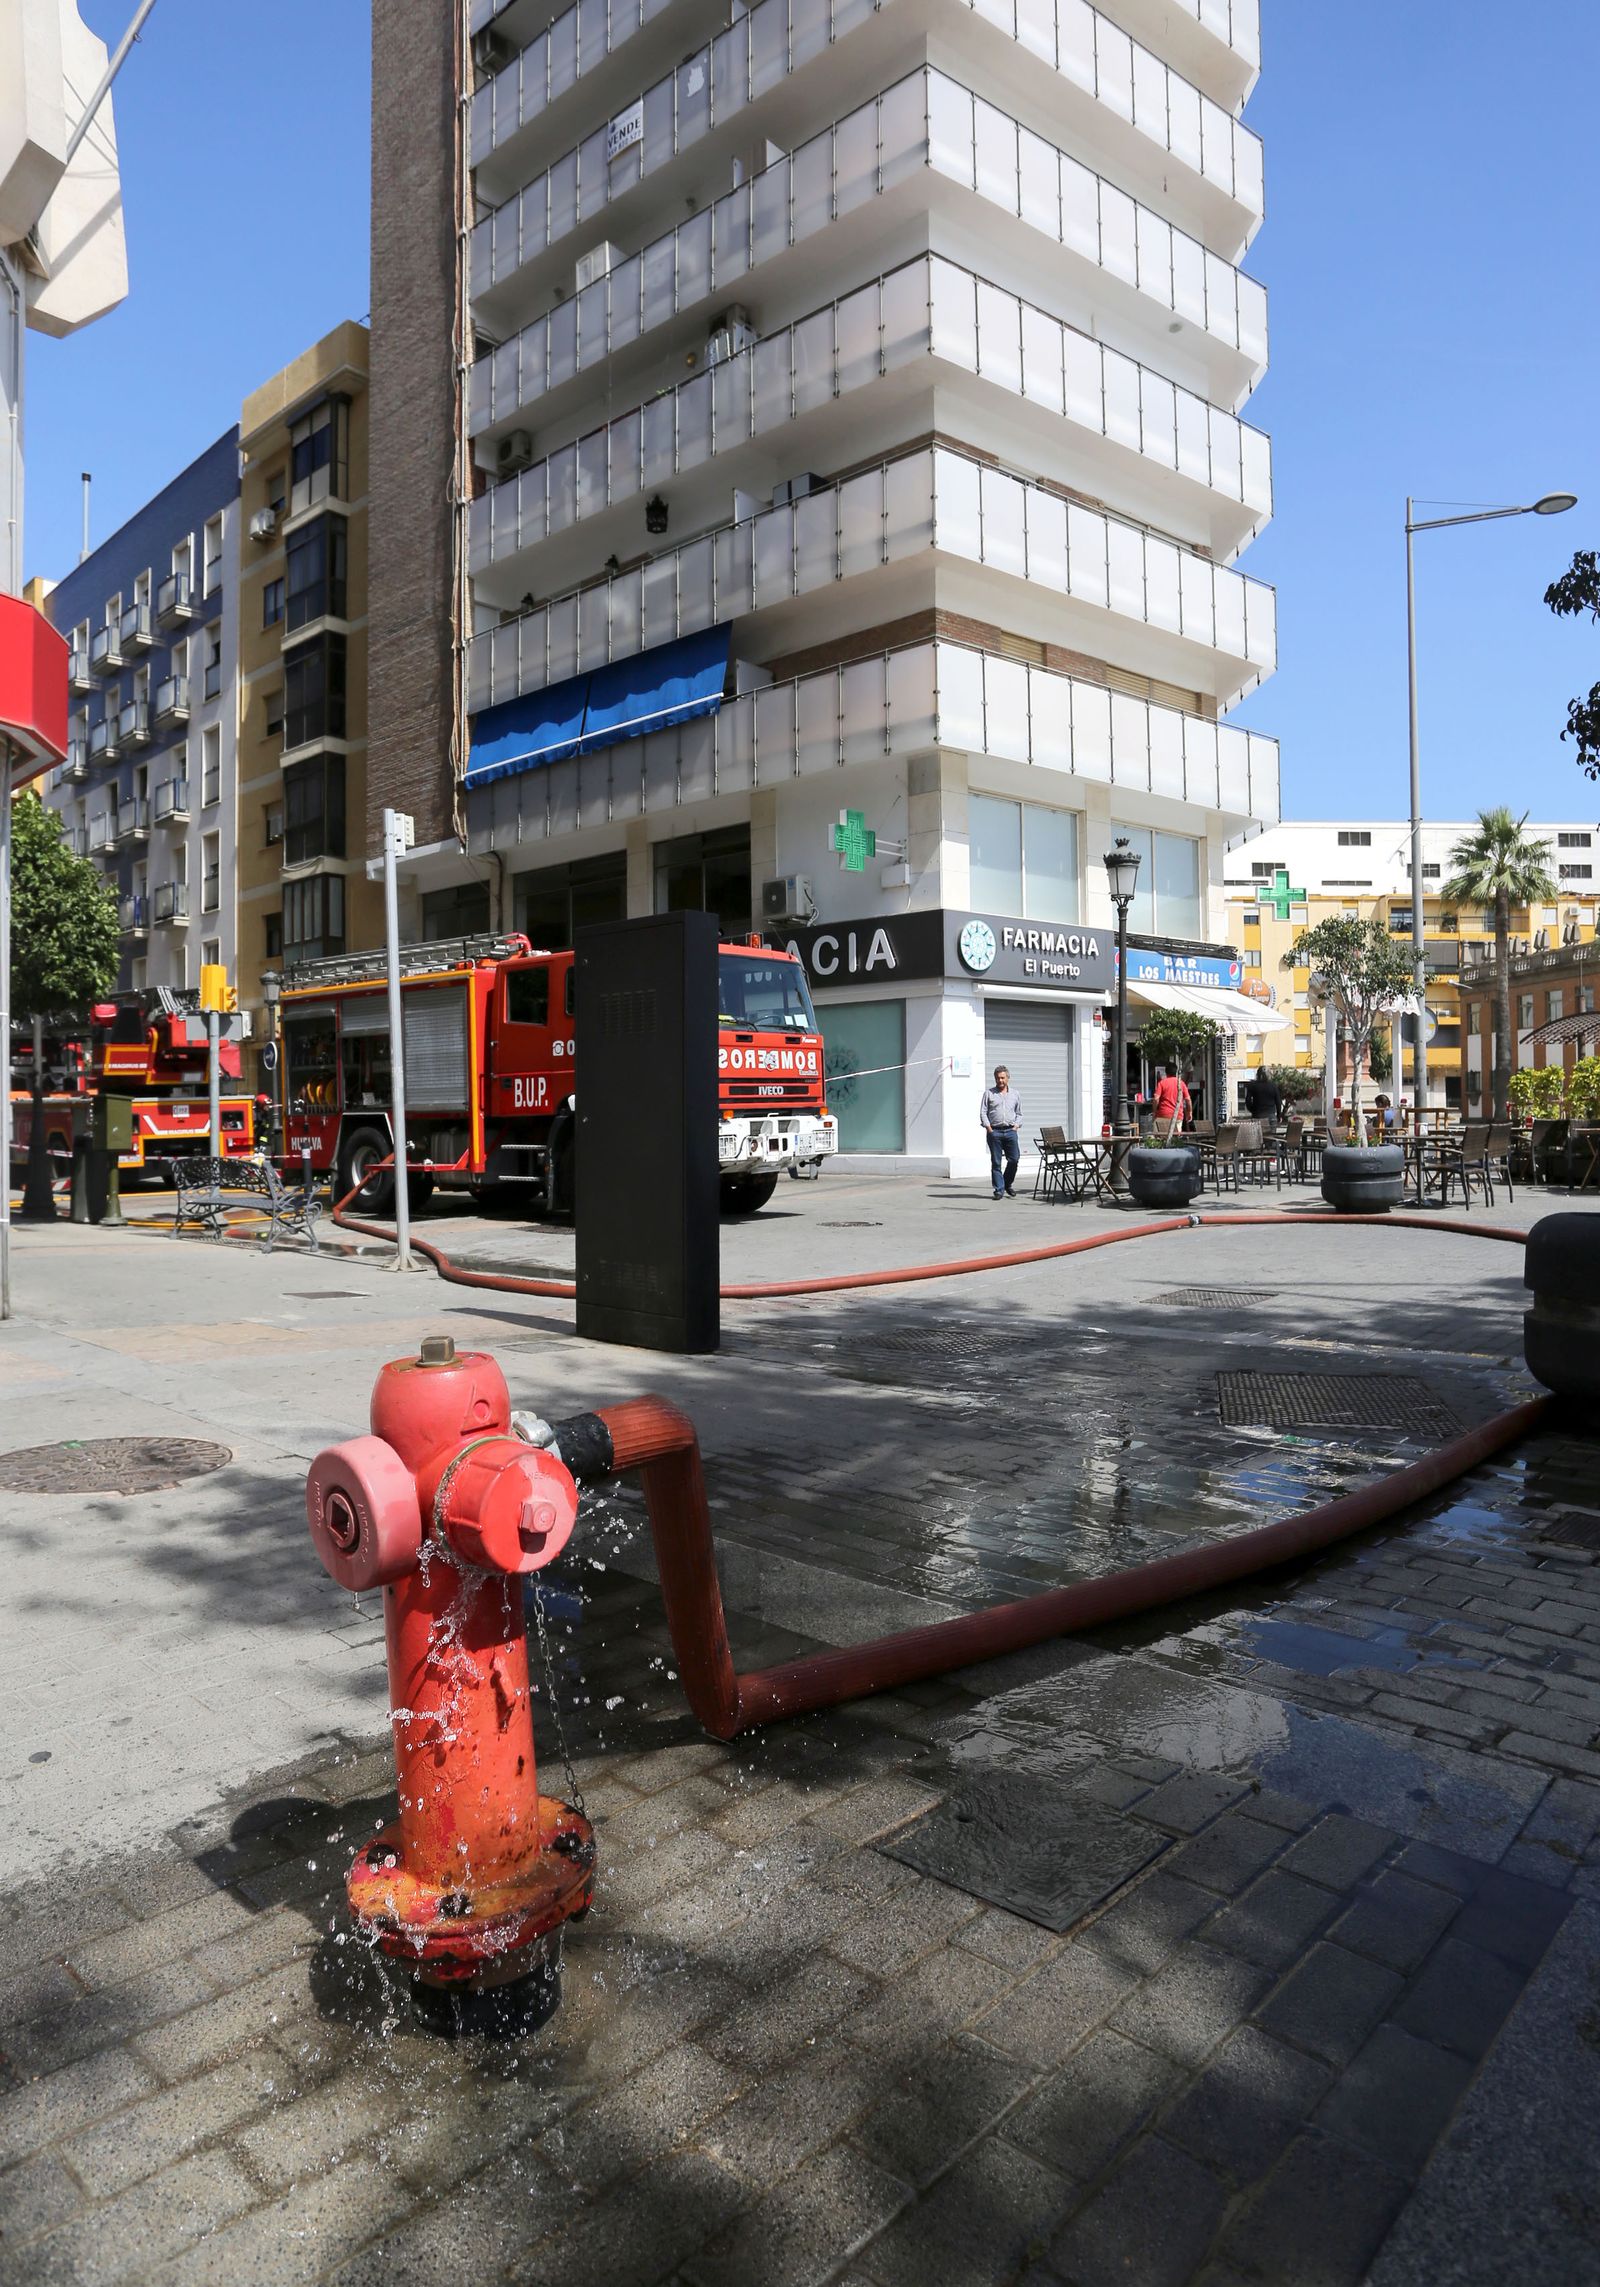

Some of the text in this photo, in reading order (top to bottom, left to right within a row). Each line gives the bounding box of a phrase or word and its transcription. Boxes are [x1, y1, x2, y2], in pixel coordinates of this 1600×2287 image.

[608, 118, 641, 148] VENDE
[763, 928, 897, 976] ACIA
[1002, 927, 1099, 957] FARMACIA
[1025, 958, 1081, 977] El Puerto
[1163, 956, 1197, 969] BAR
[1138, 965, 1159, 980] LOS
[1165, 968, 1220, 986] MAESTRES
[514, 1077, 548, 1108] B.U.P.
[758, 1086, 784, 1095] IVECO
